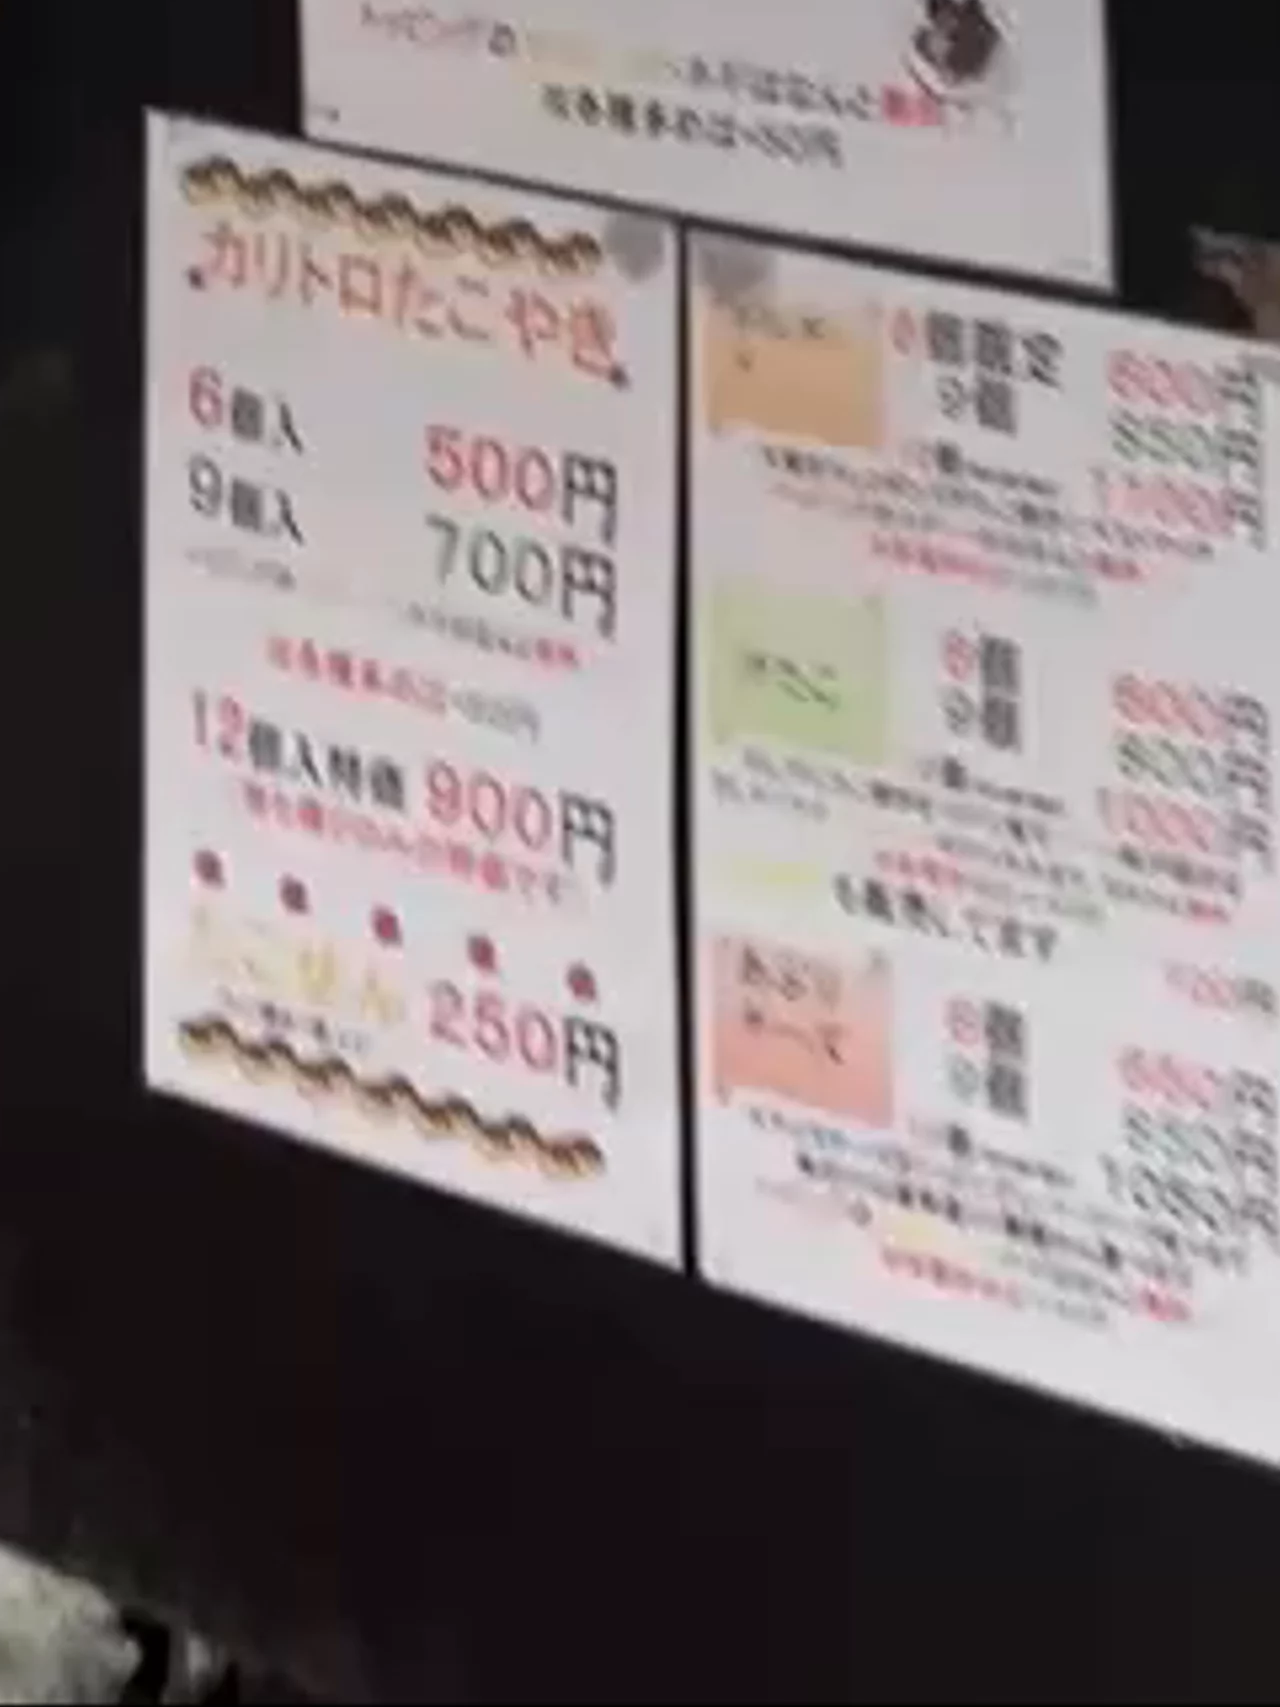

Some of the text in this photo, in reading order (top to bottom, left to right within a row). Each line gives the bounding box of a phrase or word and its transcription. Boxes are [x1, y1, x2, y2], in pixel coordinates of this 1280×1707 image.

[426, 423, 618, 546] 500円
[426, 513, 618, 642] 700円
[426, 758, 616, 888] 900円
[429, 978, 623, 1112] 250円
